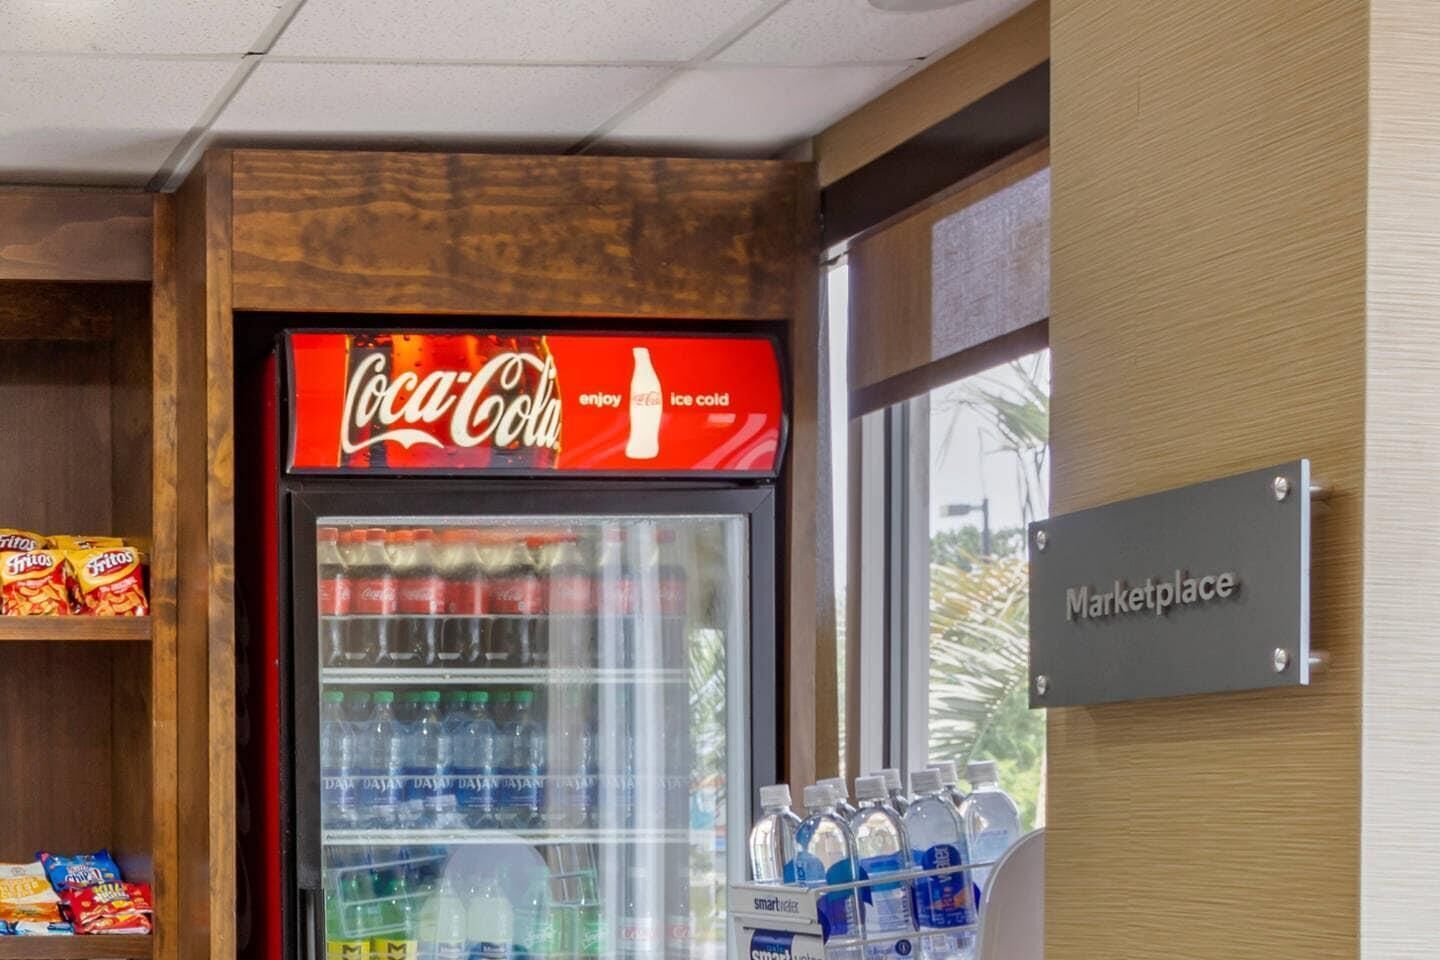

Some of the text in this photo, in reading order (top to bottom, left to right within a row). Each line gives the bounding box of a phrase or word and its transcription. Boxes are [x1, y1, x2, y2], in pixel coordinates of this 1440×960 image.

[342, 352, 561, 453] Coca-Cola
[579, 393, 622, 409] enjoy
[670, 392, 729, 407] ice cold
[8, 553, 53, 576] Fritos
[88, 550, 133, 577] Fritos
[1065, 570, 1235, 621] Marketplace
